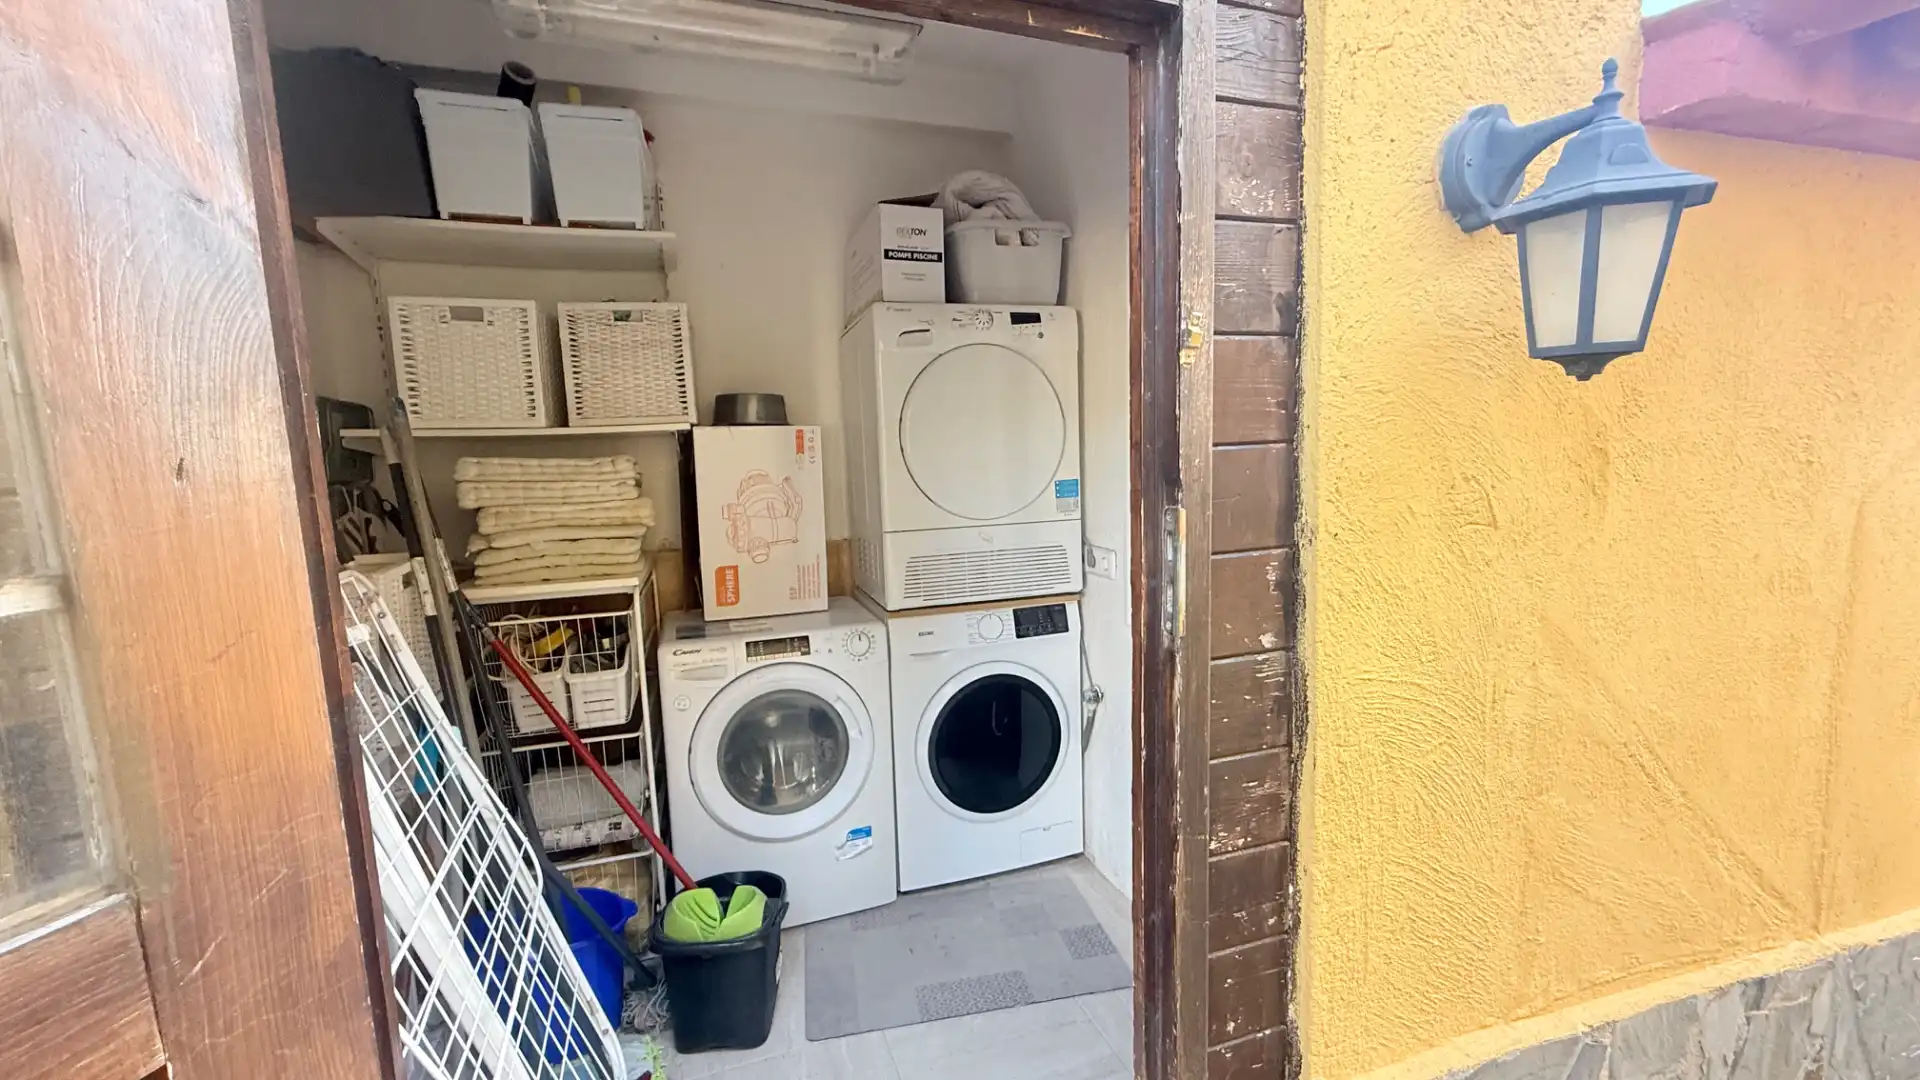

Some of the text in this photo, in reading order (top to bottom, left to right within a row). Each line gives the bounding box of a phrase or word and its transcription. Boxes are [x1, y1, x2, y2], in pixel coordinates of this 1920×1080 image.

[888, 251, 938, 261] POMPE PISCINE
[725, 567, 736, 603] SPHERE
